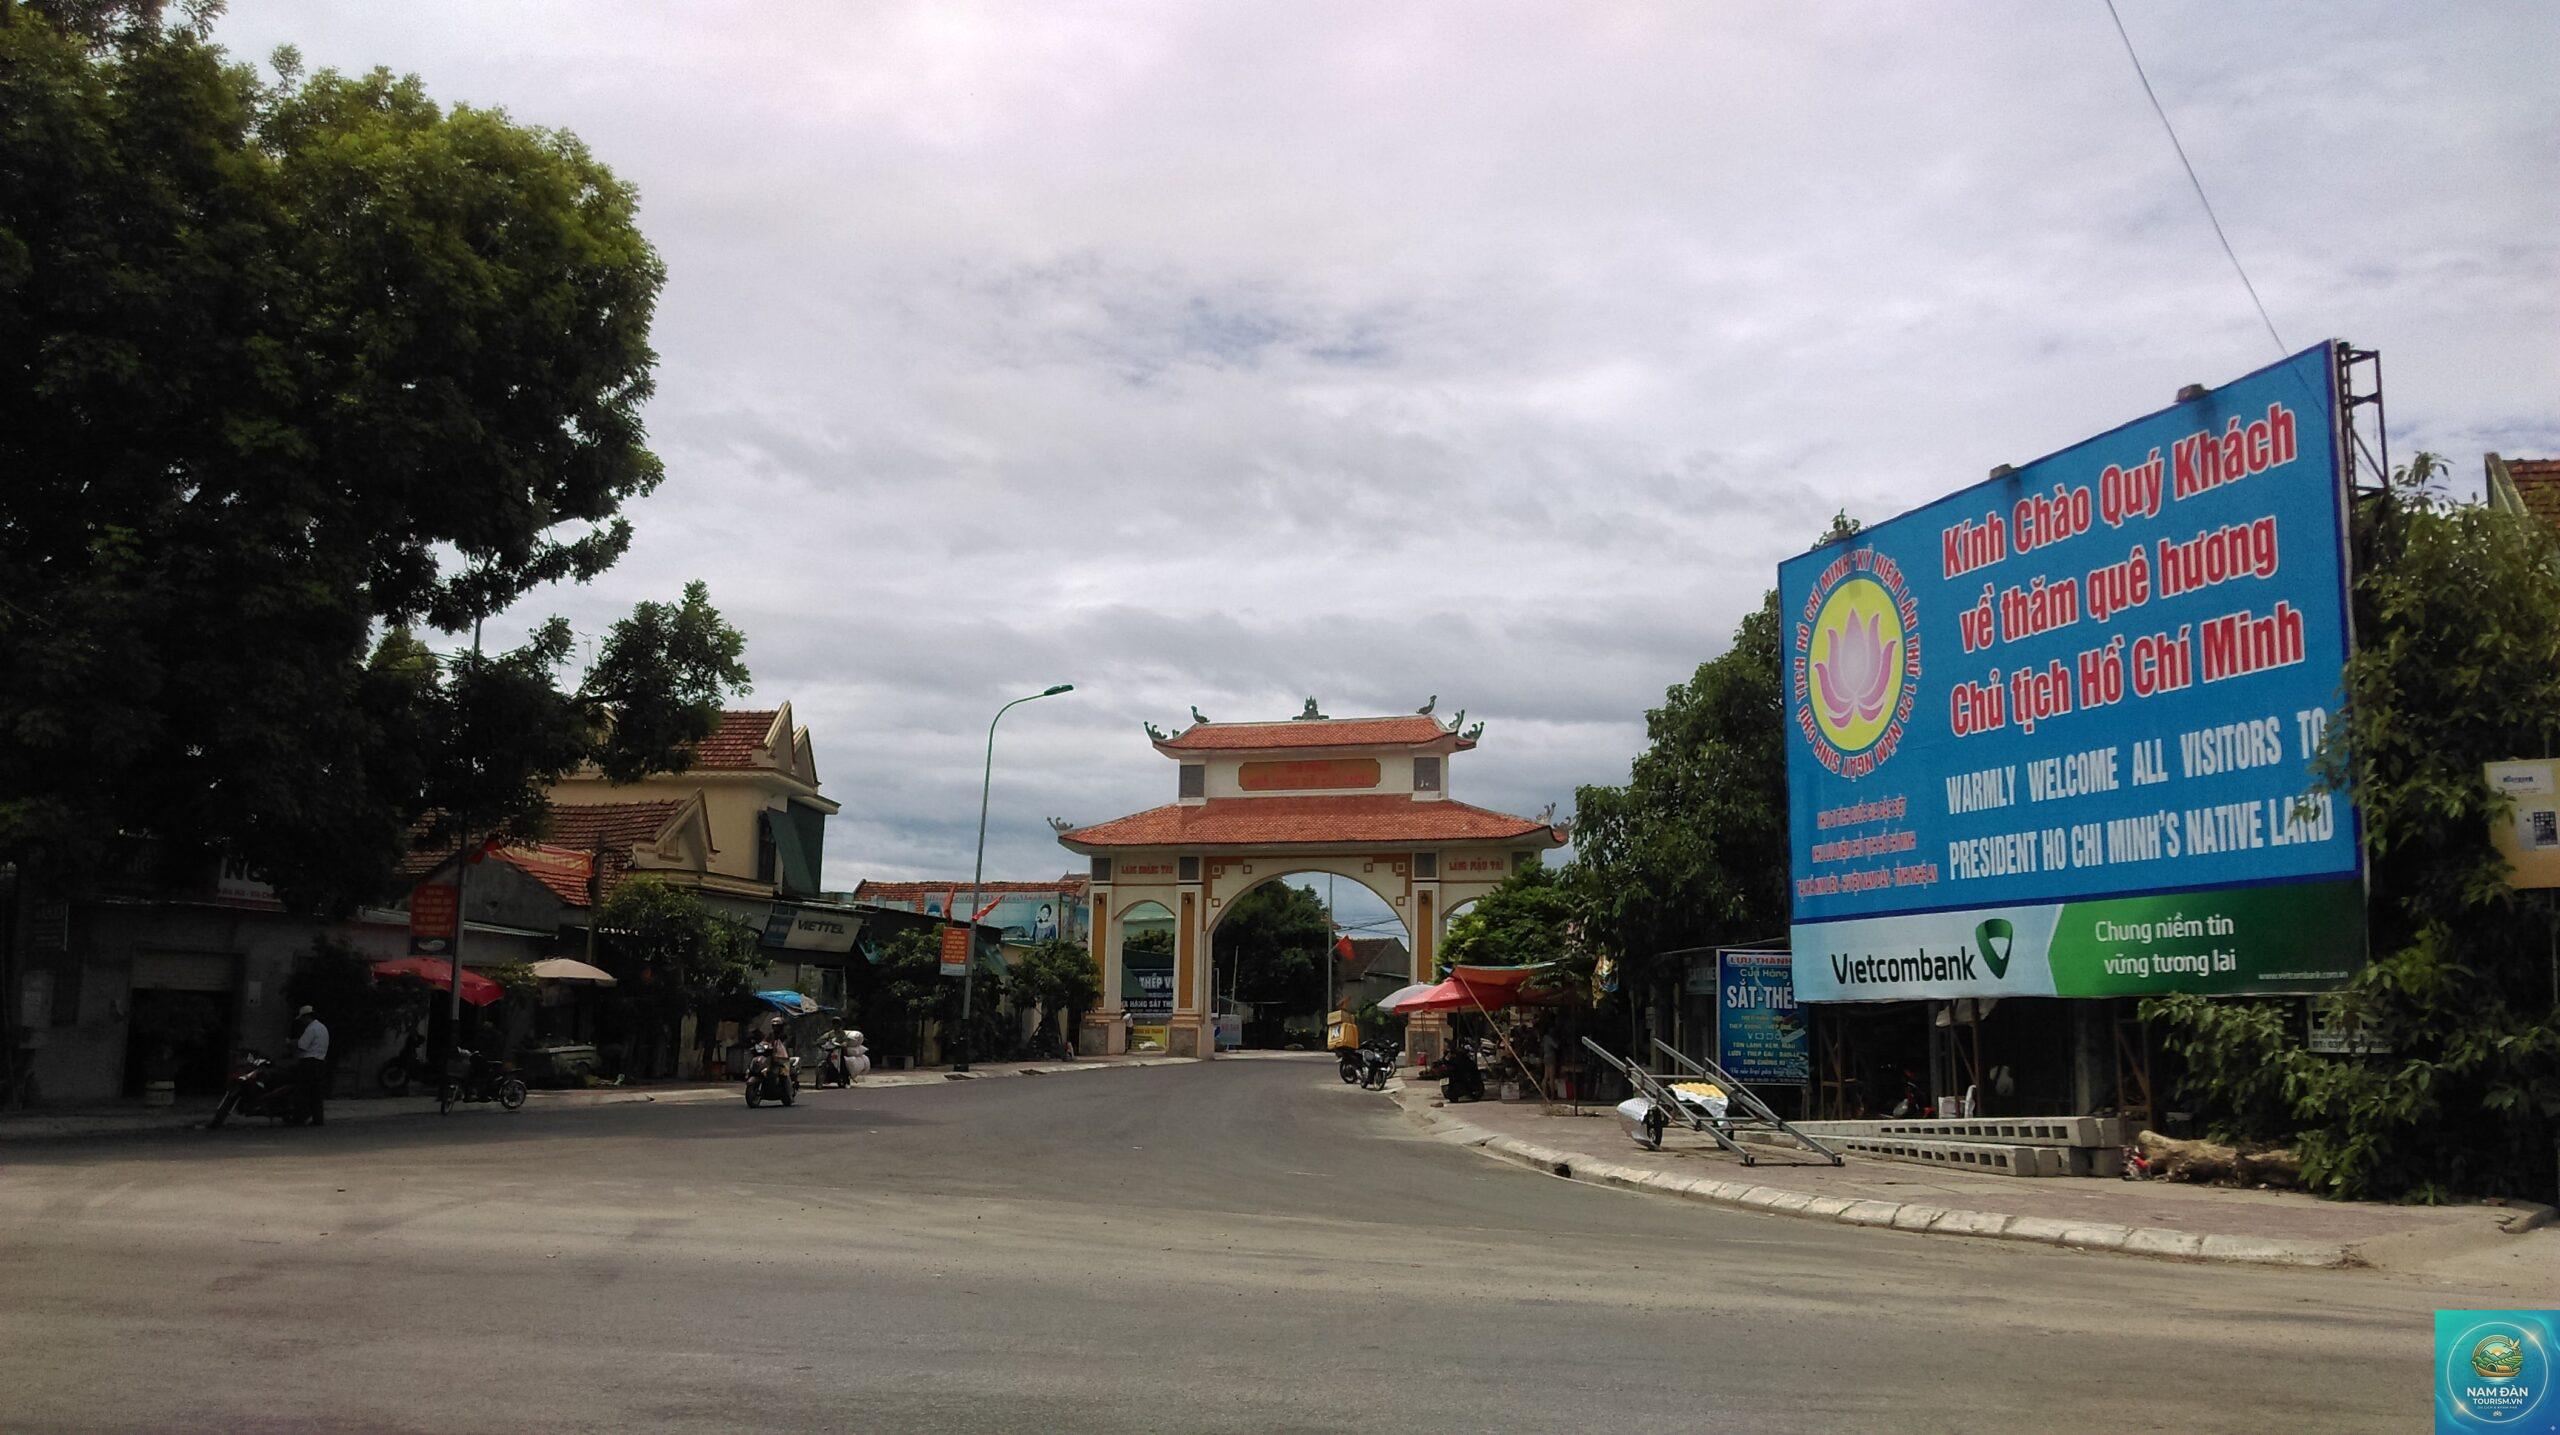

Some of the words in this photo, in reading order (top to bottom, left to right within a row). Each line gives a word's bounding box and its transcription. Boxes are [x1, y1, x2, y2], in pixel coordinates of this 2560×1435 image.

[1942, 511, 2006, 580] Kính
[2013, 483, 2092, 555] Chào
[2100, 446, 2165, 529] Quý
[2172, 401, 2297, 501] Khách
[1820, 551, 1851, 595] MINH
[1960, 583, 1994, 653] về
[2000, 575, 2079, 643] thăm
[2087, 545, 2150, 623] quê
[2158, 515, 2278, 599] hương
[1951, 668, 2005, 737] Chủ
[2010, 660, 2072, 735] tịch
[2078, 634, 2125, 710] Hồ
[2132, 624, 2192, 698] Chí
[2200, 600, 2305, 684] Minh
[1897, 684, 1917, 723] 126
[1812, 735, 1840, 774] SINH
[1946, 765, 2016, 815] WARMLY
[2027, 746, 2119, 802] WELCOME
[2132, 738, 2168, 786] ALL
[2180, 716, 2282, 778] VISITORS
[2296, 707, 2328, 759] TO
[1949, 831, 2038, 881] PRESIDENT
[2041, 827, 2067, 871] HO
[2071, 822, 2104, 868] CHI
[2107, 809, 2181, 864] MINH'S
[2185, 800, 2264, 856] NATIVE
[2268, 793, 2334, 846] LAND
[797, 919, 844, 934] VIETTEL
[2095, 920, 2152, 944] Chung
[2155, 912, 2203, 938] niềm
[2207, 914, 2234, 936] tin
[1831, 946, 1977, 984] Vietcombank
[2104, 953, 2149, 977] vững
[2213, 949, 2236, 972] lai
